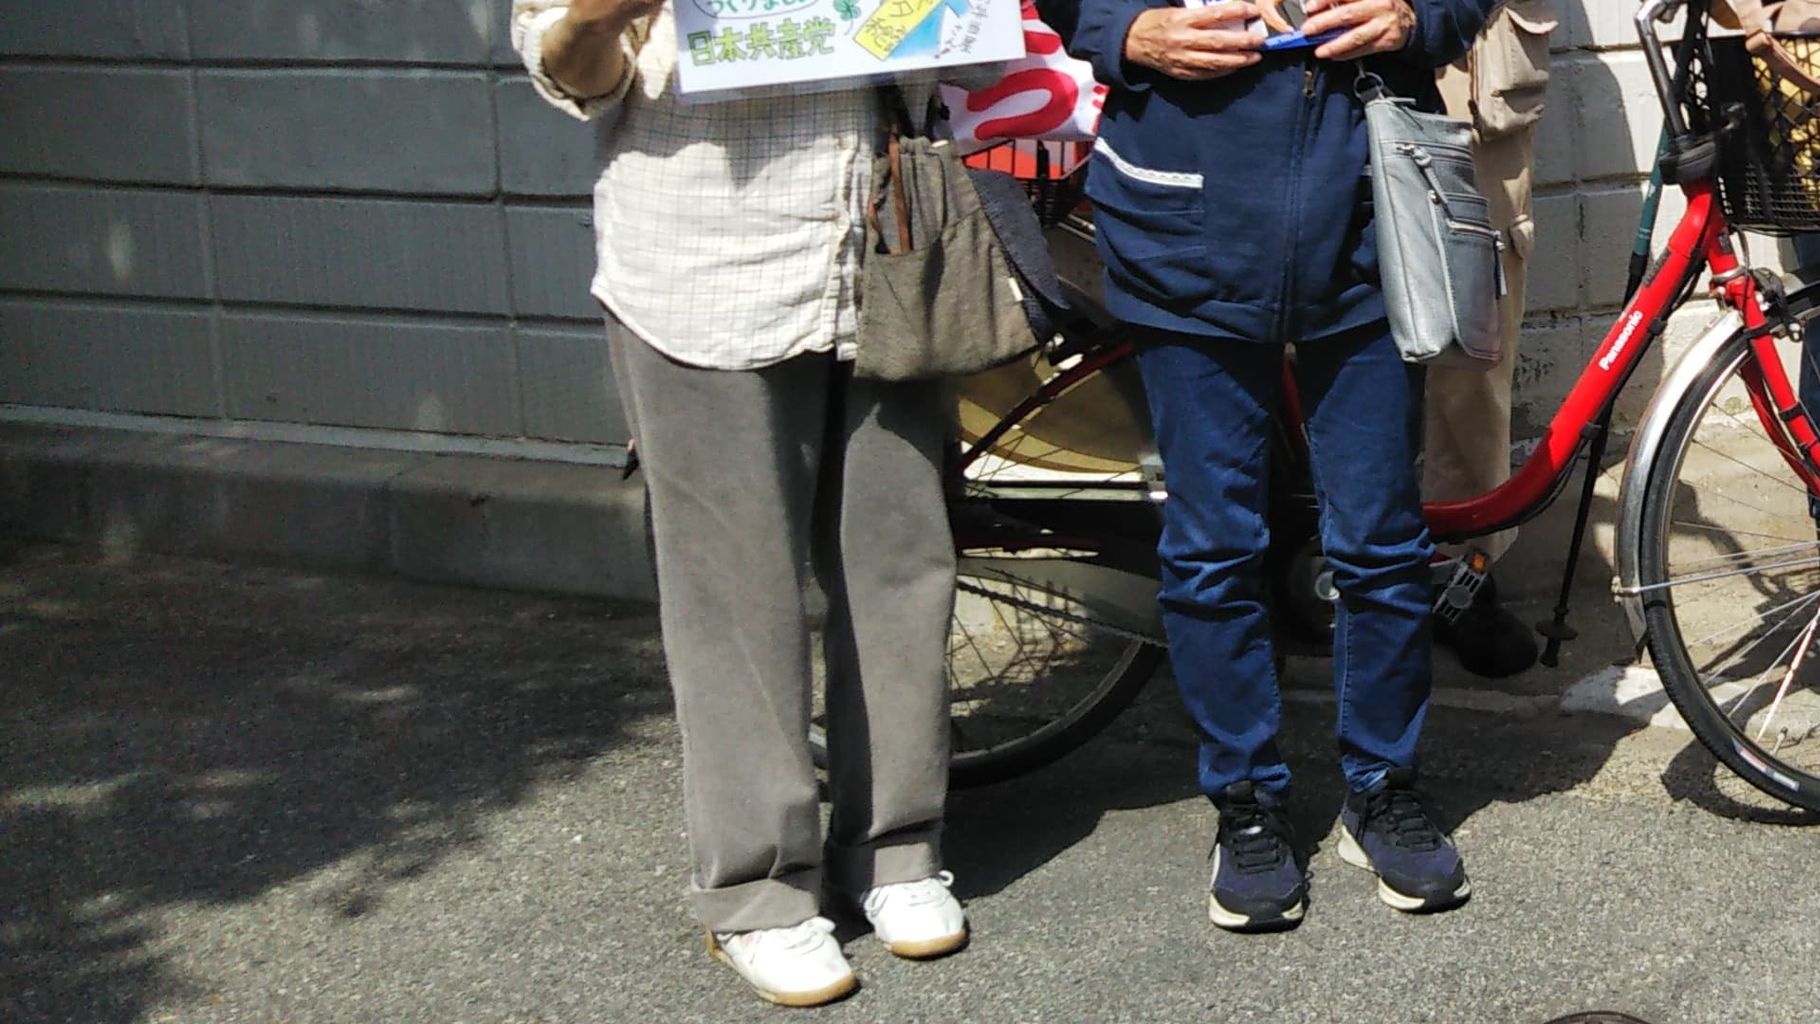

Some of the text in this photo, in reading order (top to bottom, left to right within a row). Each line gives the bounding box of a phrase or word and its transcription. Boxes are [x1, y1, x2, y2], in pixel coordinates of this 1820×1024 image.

[687, 17, 836, 67] 日本共産党
[1598, 309, 1644, 371] Panasonic
